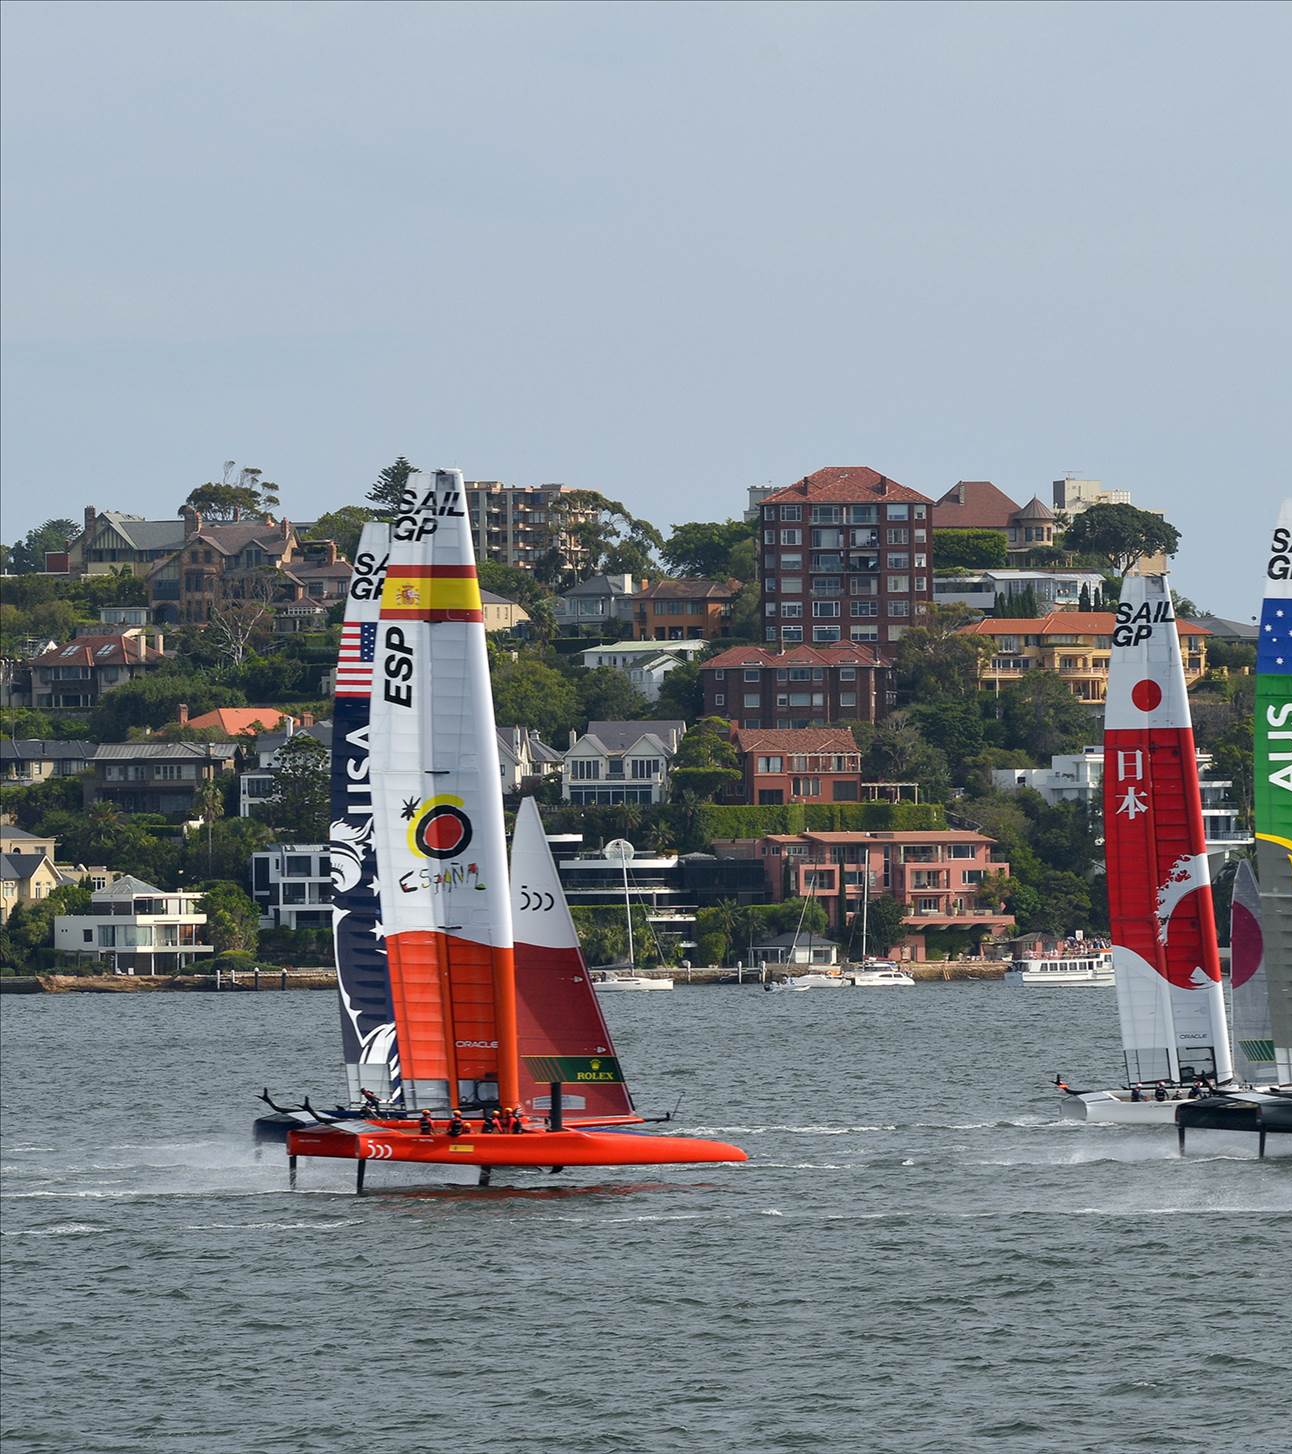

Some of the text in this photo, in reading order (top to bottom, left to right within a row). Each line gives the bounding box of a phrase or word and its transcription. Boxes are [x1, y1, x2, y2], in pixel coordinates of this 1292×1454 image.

[399, 489, 465, 517] SAIL
[393, 516, 438, 541] GP
[1116, 601, 1176, 624] SAIL
[1112, 624, 1153, 647] GP
[384, 626, 414, 708] ESP
[1115, 749, 1149, 820] 日本
[455, 1040, 499, 1049] ORACLE
[576, 1072, 614, 1080] ROLEX
